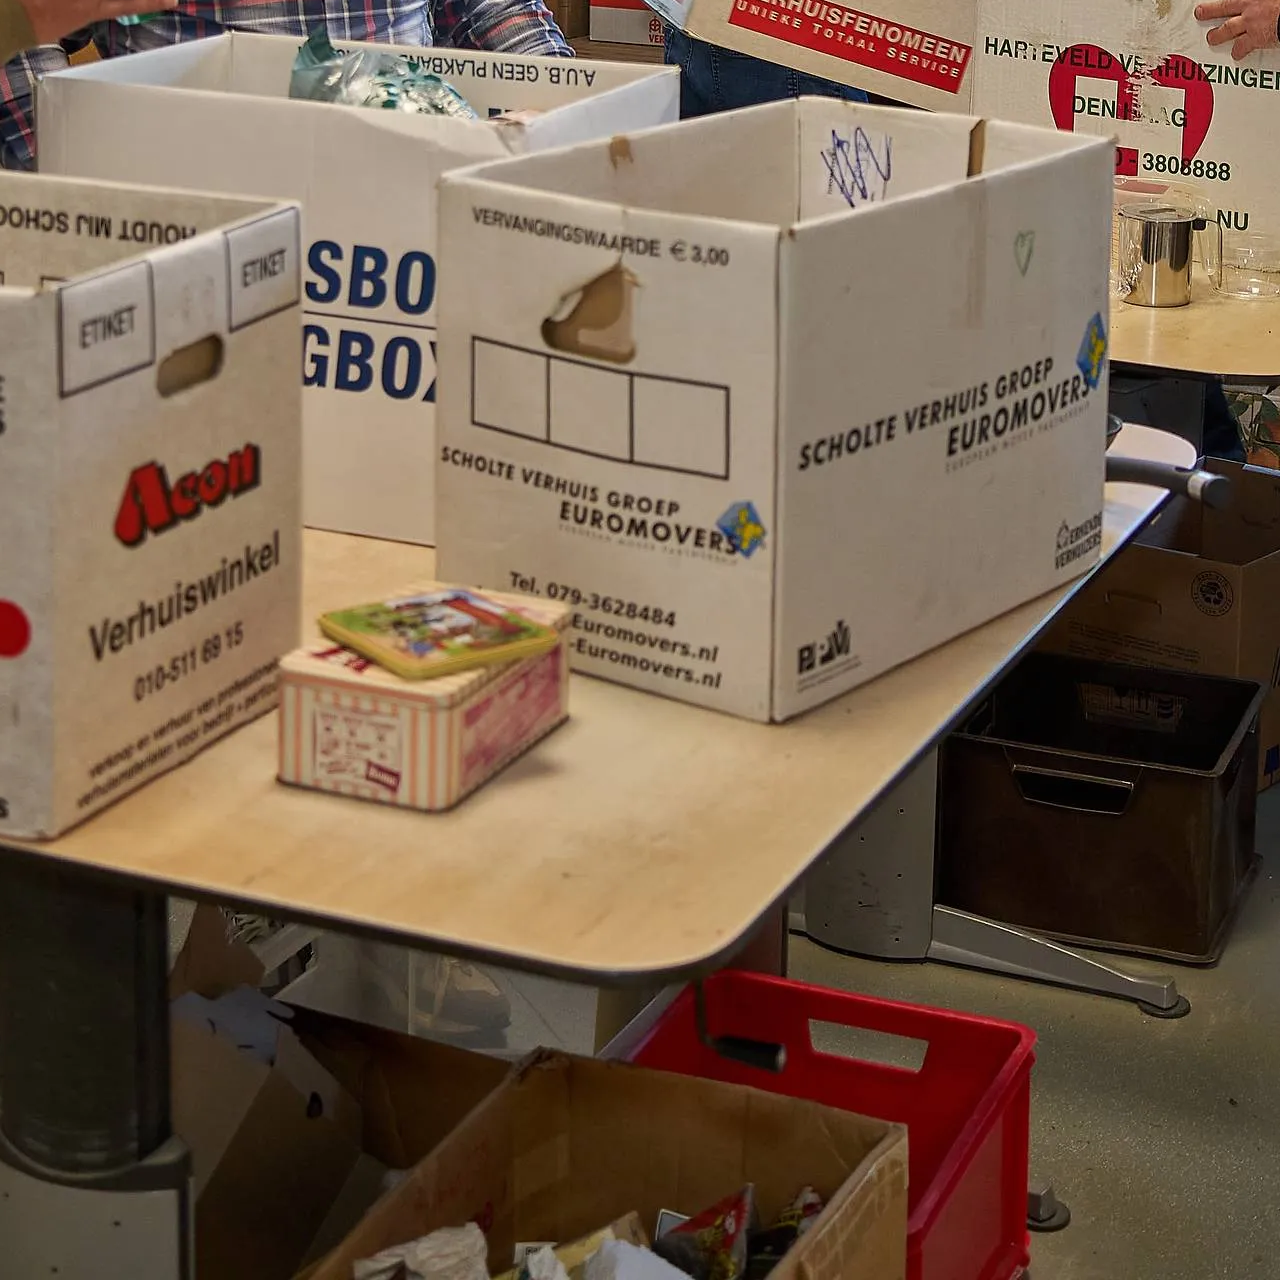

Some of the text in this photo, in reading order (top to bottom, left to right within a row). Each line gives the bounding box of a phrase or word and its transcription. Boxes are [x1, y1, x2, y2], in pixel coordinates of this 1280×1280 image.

[492, 61, 596, 87] A.U.B. GEEN
[1072, 95, 1116, 119] DEN
[1142, 152, 1231, 181] 3808888
[76, 214, 112, 238] MIJ
[472, 206, 730, 268] VERVANGINGSWAARDE € 3,00
[1217, 209, 1249, 231] NU
[241, 247, 287, 287] ETIKET
[305, 239, 436, 316] SBO
[78, 305, 138, 349] ETIKET
[798, 357, 1054, 471] SCHOLTE VERHUIS GROEP
[946, 374, 1090, 458] EUROMOVERS
[114, 441, 262, 549] Acon
[441, 446, 680, 518] SCHOLTE VERHUIS GROEP
[559, 501, 739, 557] EUROMOVERS
[1055, 532, 1102, 570] VERHUIZERS
[89, 530, 280, 663] Verhuiswinkel
[510, 571, 677, 628] Tel. 079-3628484
[133, 620, 244, 704] 010-511 69 15
